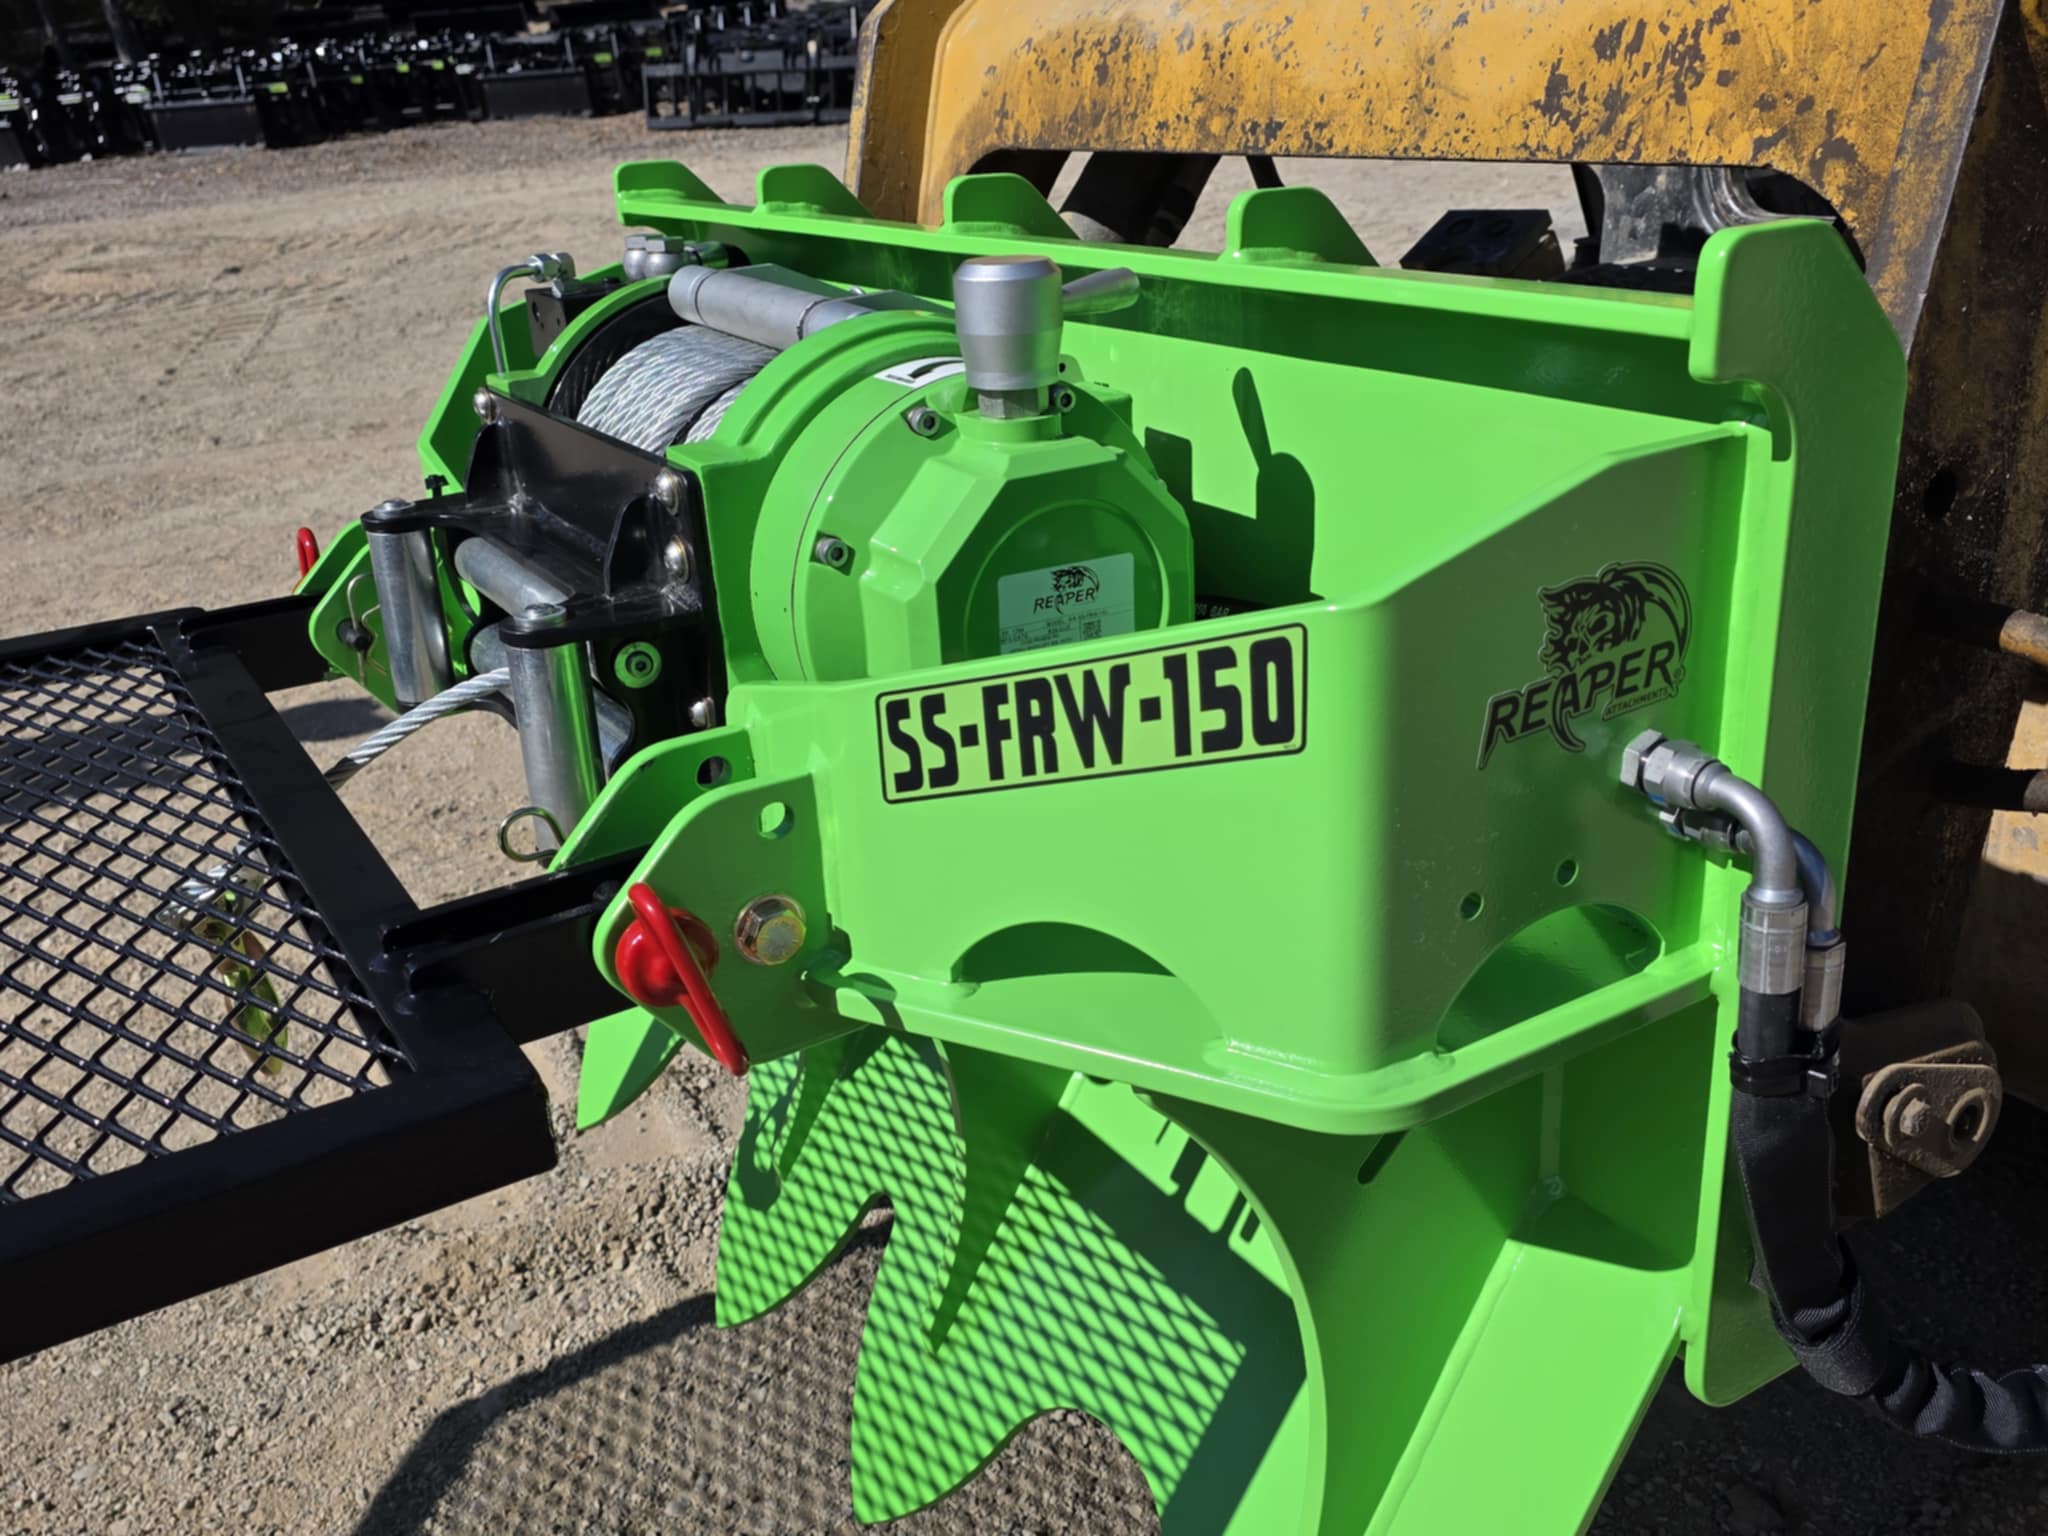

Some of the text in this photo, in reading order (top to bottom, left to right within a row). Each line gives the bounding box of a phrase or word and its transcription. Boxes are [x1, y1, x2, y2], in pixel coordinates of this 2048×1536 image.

[1033, 587, 1096, 614] REAPER
[886, 636, 1295, 793] SS-FRW-150
[1480, 640, 1676, 769] REAPER
